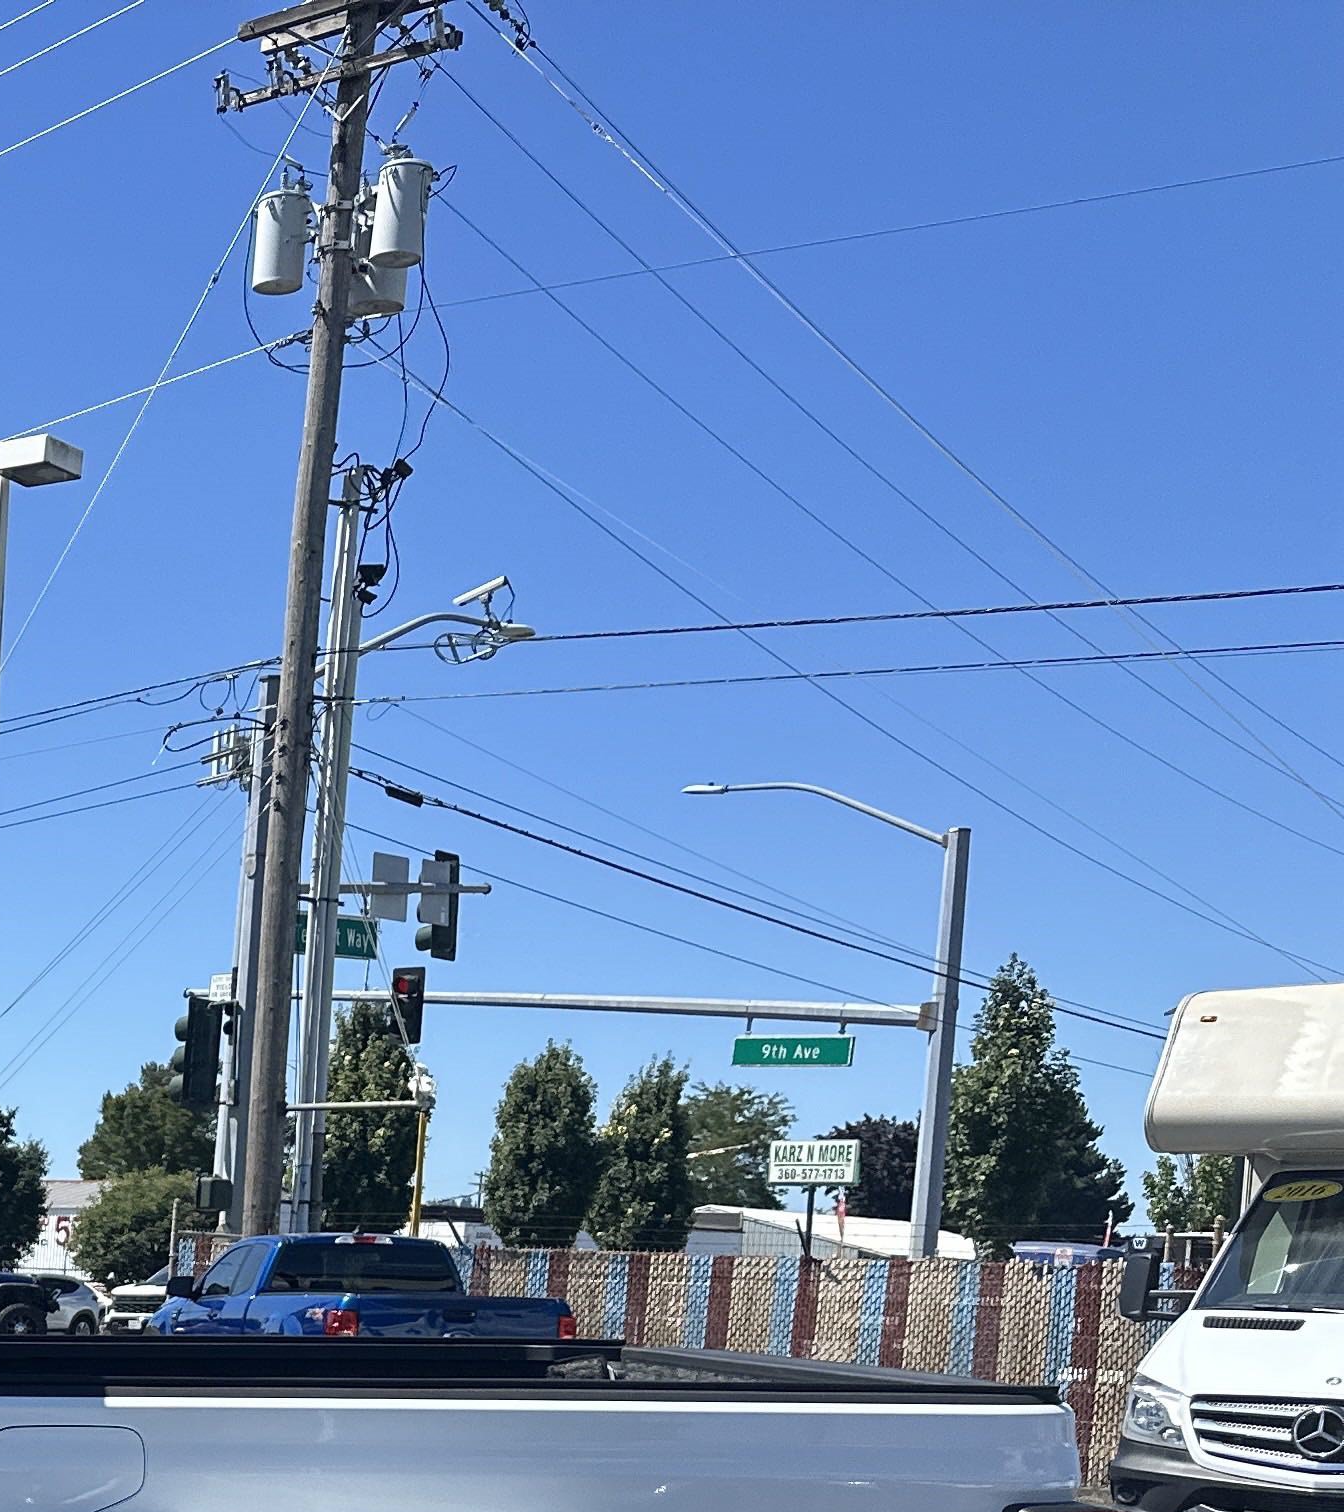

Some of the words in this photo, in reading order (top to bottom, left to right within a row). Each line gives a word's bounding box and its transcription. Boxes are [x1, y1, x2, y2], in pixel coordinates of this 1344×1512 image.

[346, 928, 369, 953] Way
[761, 1043, 787, 1059] 9th
[793, 1043, 820, 1059] Ave
[774, 1144, 803, 1163] KARZ
[807, 1144, 815, 1163] N
[818, 1144, 853, 1163] MORE
[777, 1168, 845, 1180] 360-577-1713
[1274, 1183, 1330, 1199] 2016
